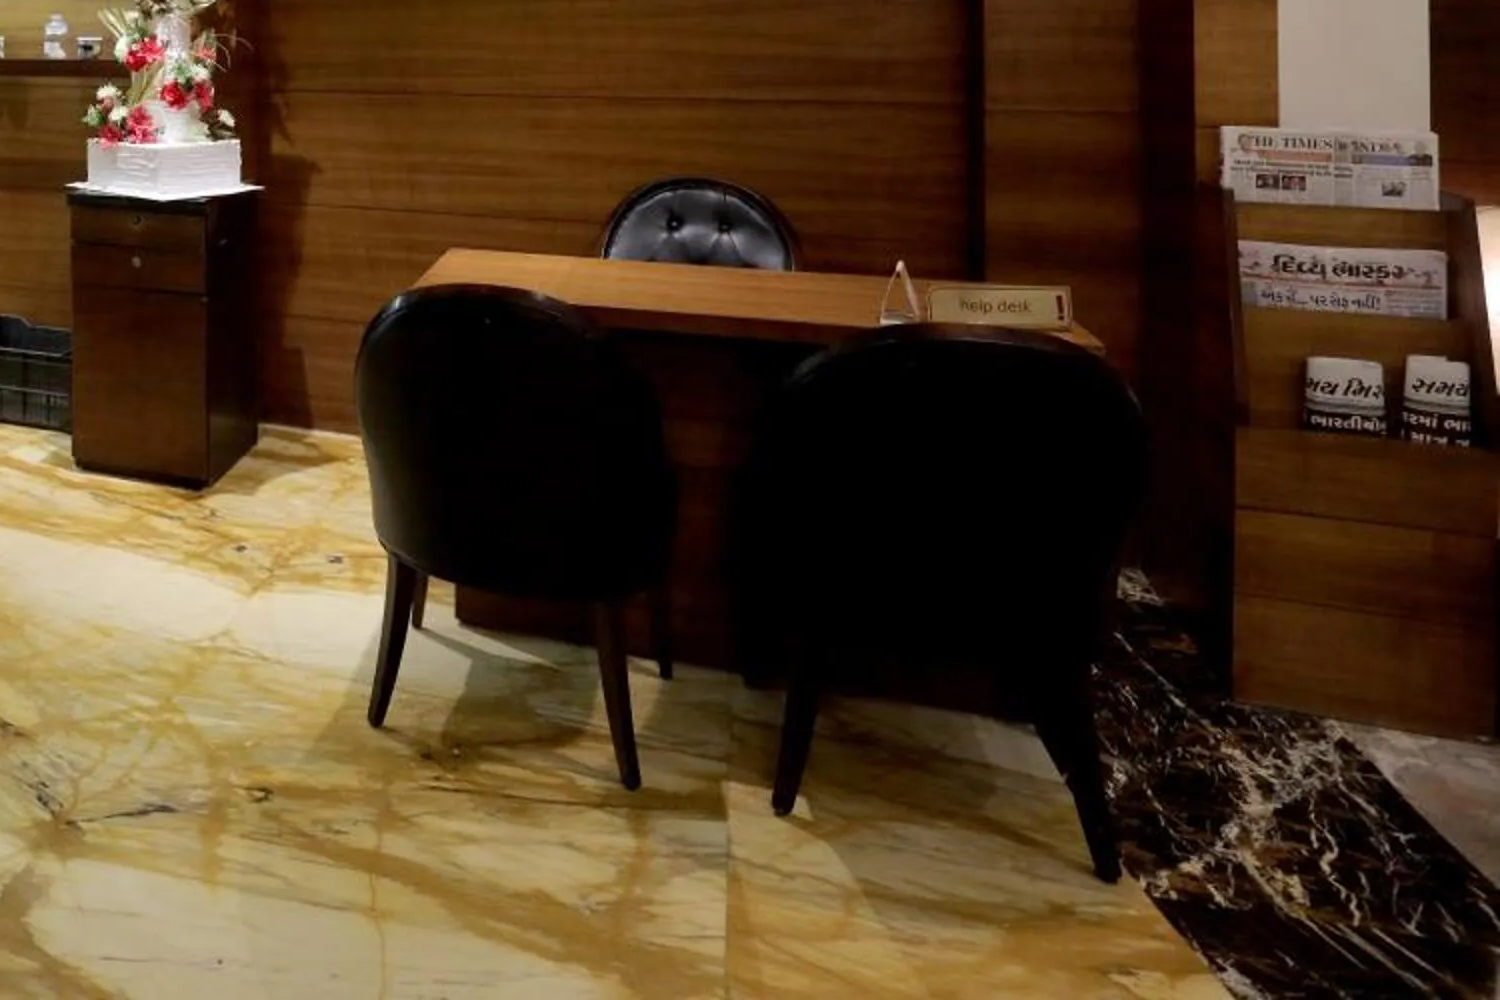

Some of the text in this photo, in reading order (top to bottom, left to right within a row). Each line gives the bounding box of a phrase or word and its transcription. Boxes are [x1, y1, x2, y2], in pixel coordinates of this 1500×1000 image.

[1281, 136, 1333, 150] TIMES
[960, 298, 1032, 314] help desk
